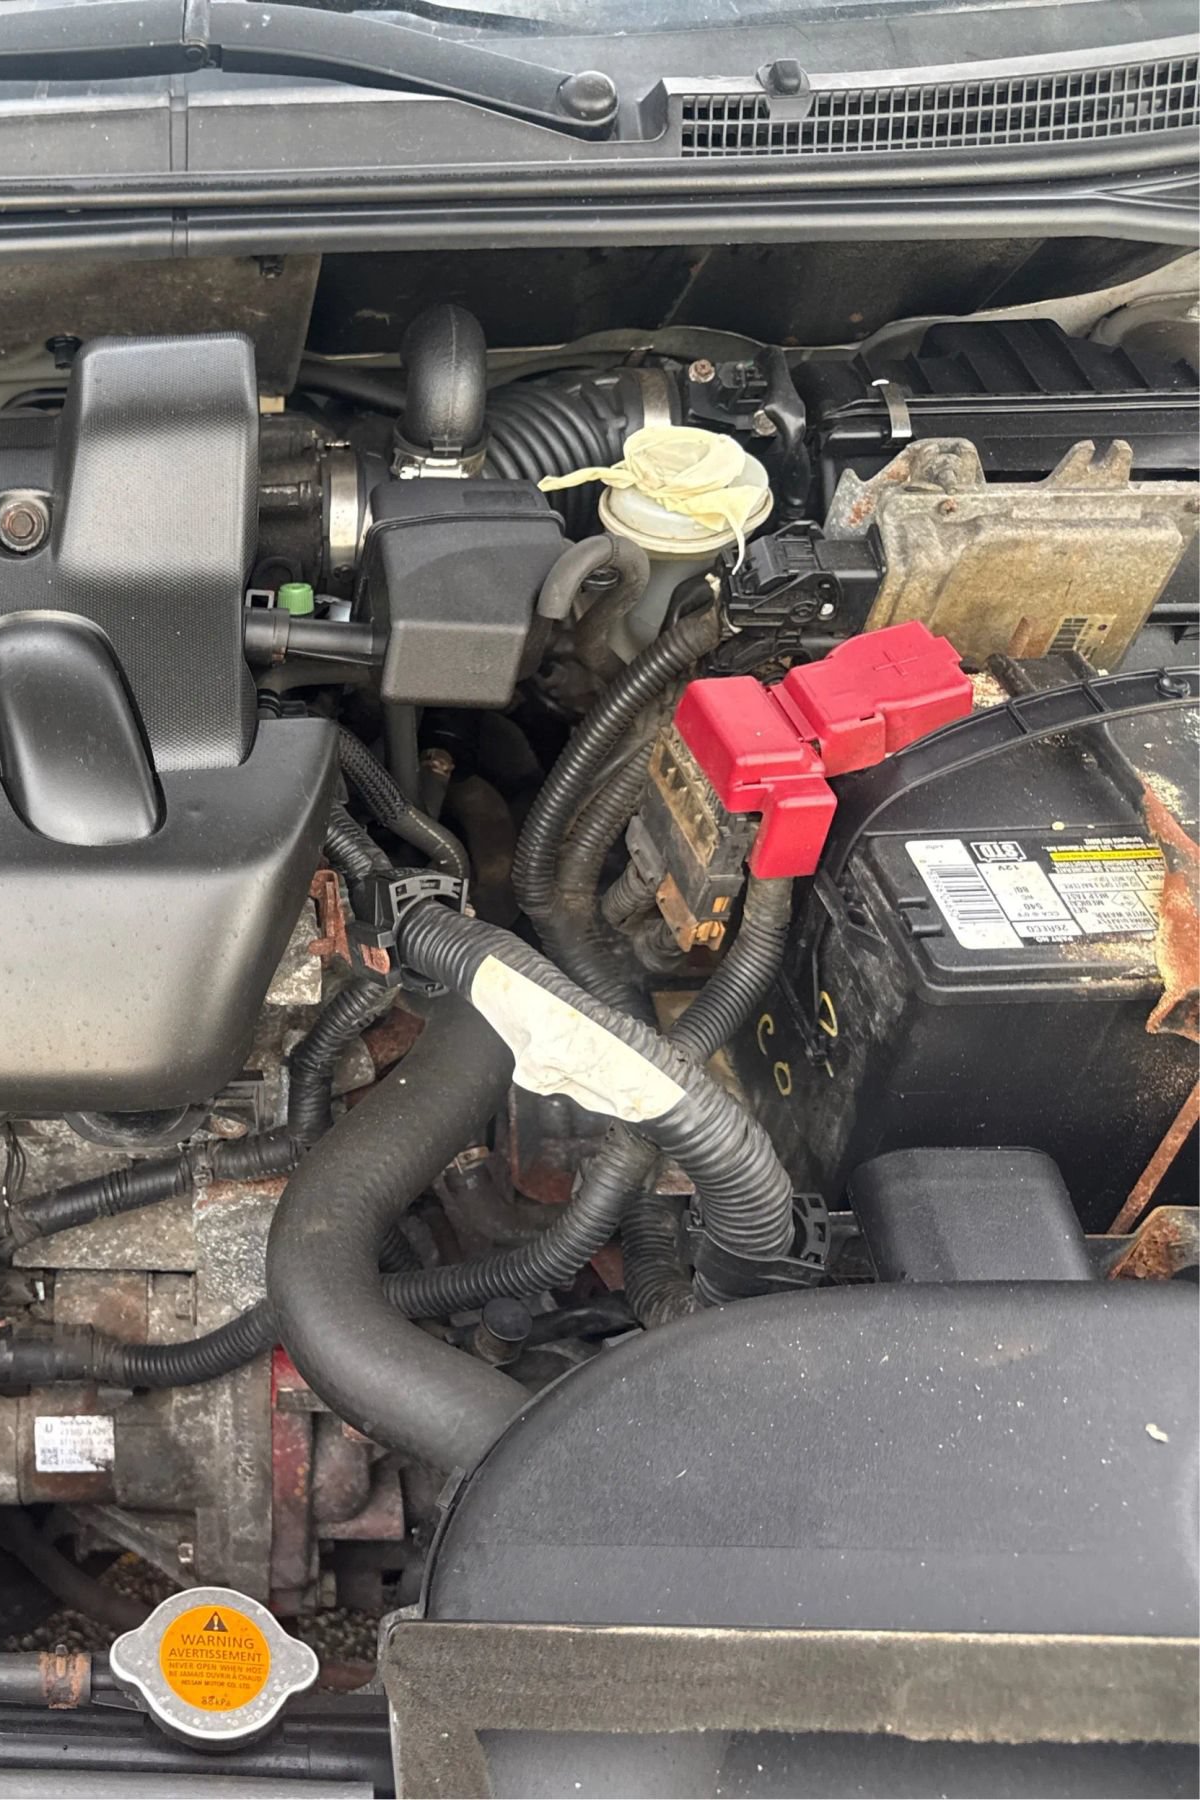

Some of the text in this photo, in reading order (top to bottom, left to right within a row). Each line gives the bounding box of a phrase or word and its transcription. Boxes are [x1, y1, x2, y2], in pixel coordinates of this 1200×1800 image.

[180, 1633, 255, 1650] WARNING
[168, 1648, 262, 1663] AVERTISSEMENT
[169, 1662, 194, 1670] NEVER
[196, 1663, 217, 1671] OPEN
[220, 1664, 244, 1673] WHEN
[179, 1671, 204, 1679] JAMAIS
